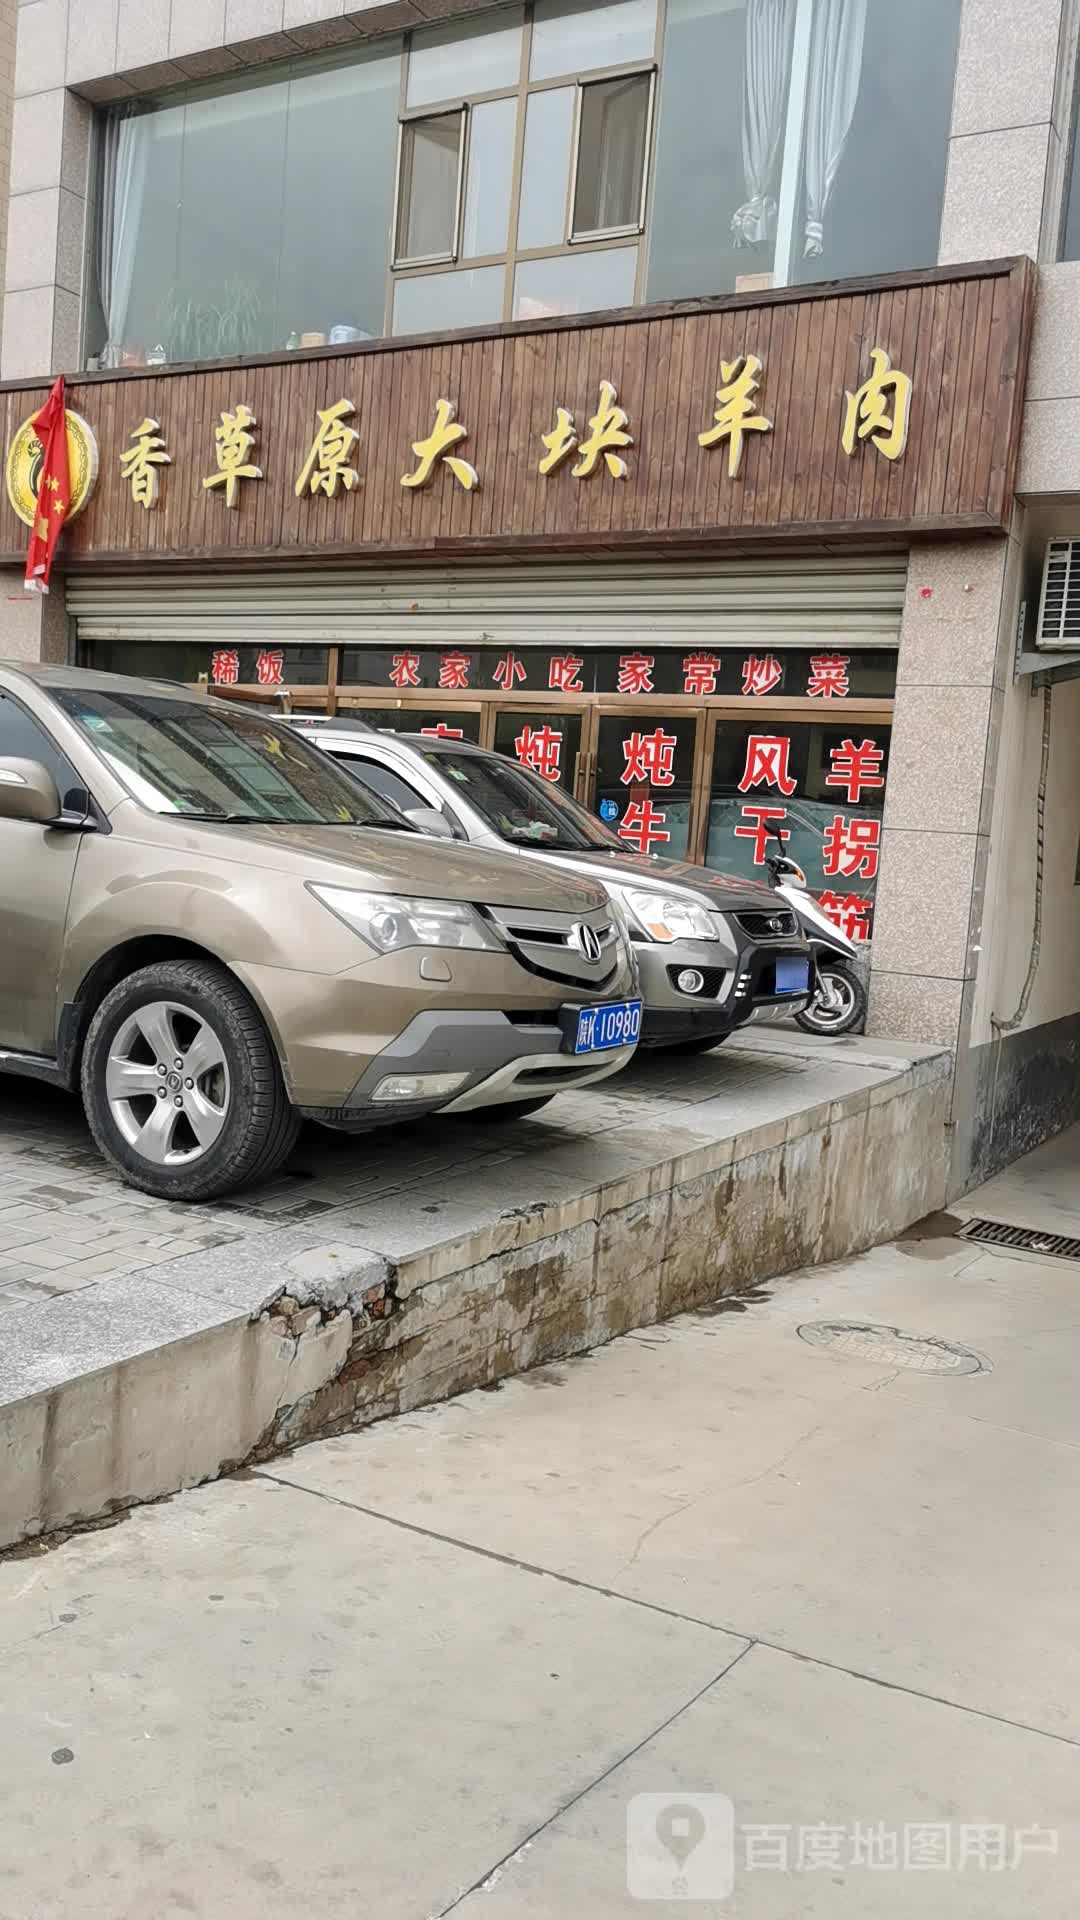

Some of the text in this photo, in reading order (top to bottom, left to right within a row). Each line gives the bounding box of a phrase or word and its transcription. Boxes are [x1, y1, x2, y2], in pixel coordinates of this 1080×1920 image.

[120, 347, 913, 510] 香草原大块羊肉
[211, 650, 285, 685] 稀饭
[388, 650, 850, 698] 农家小吃 家常炒菜
